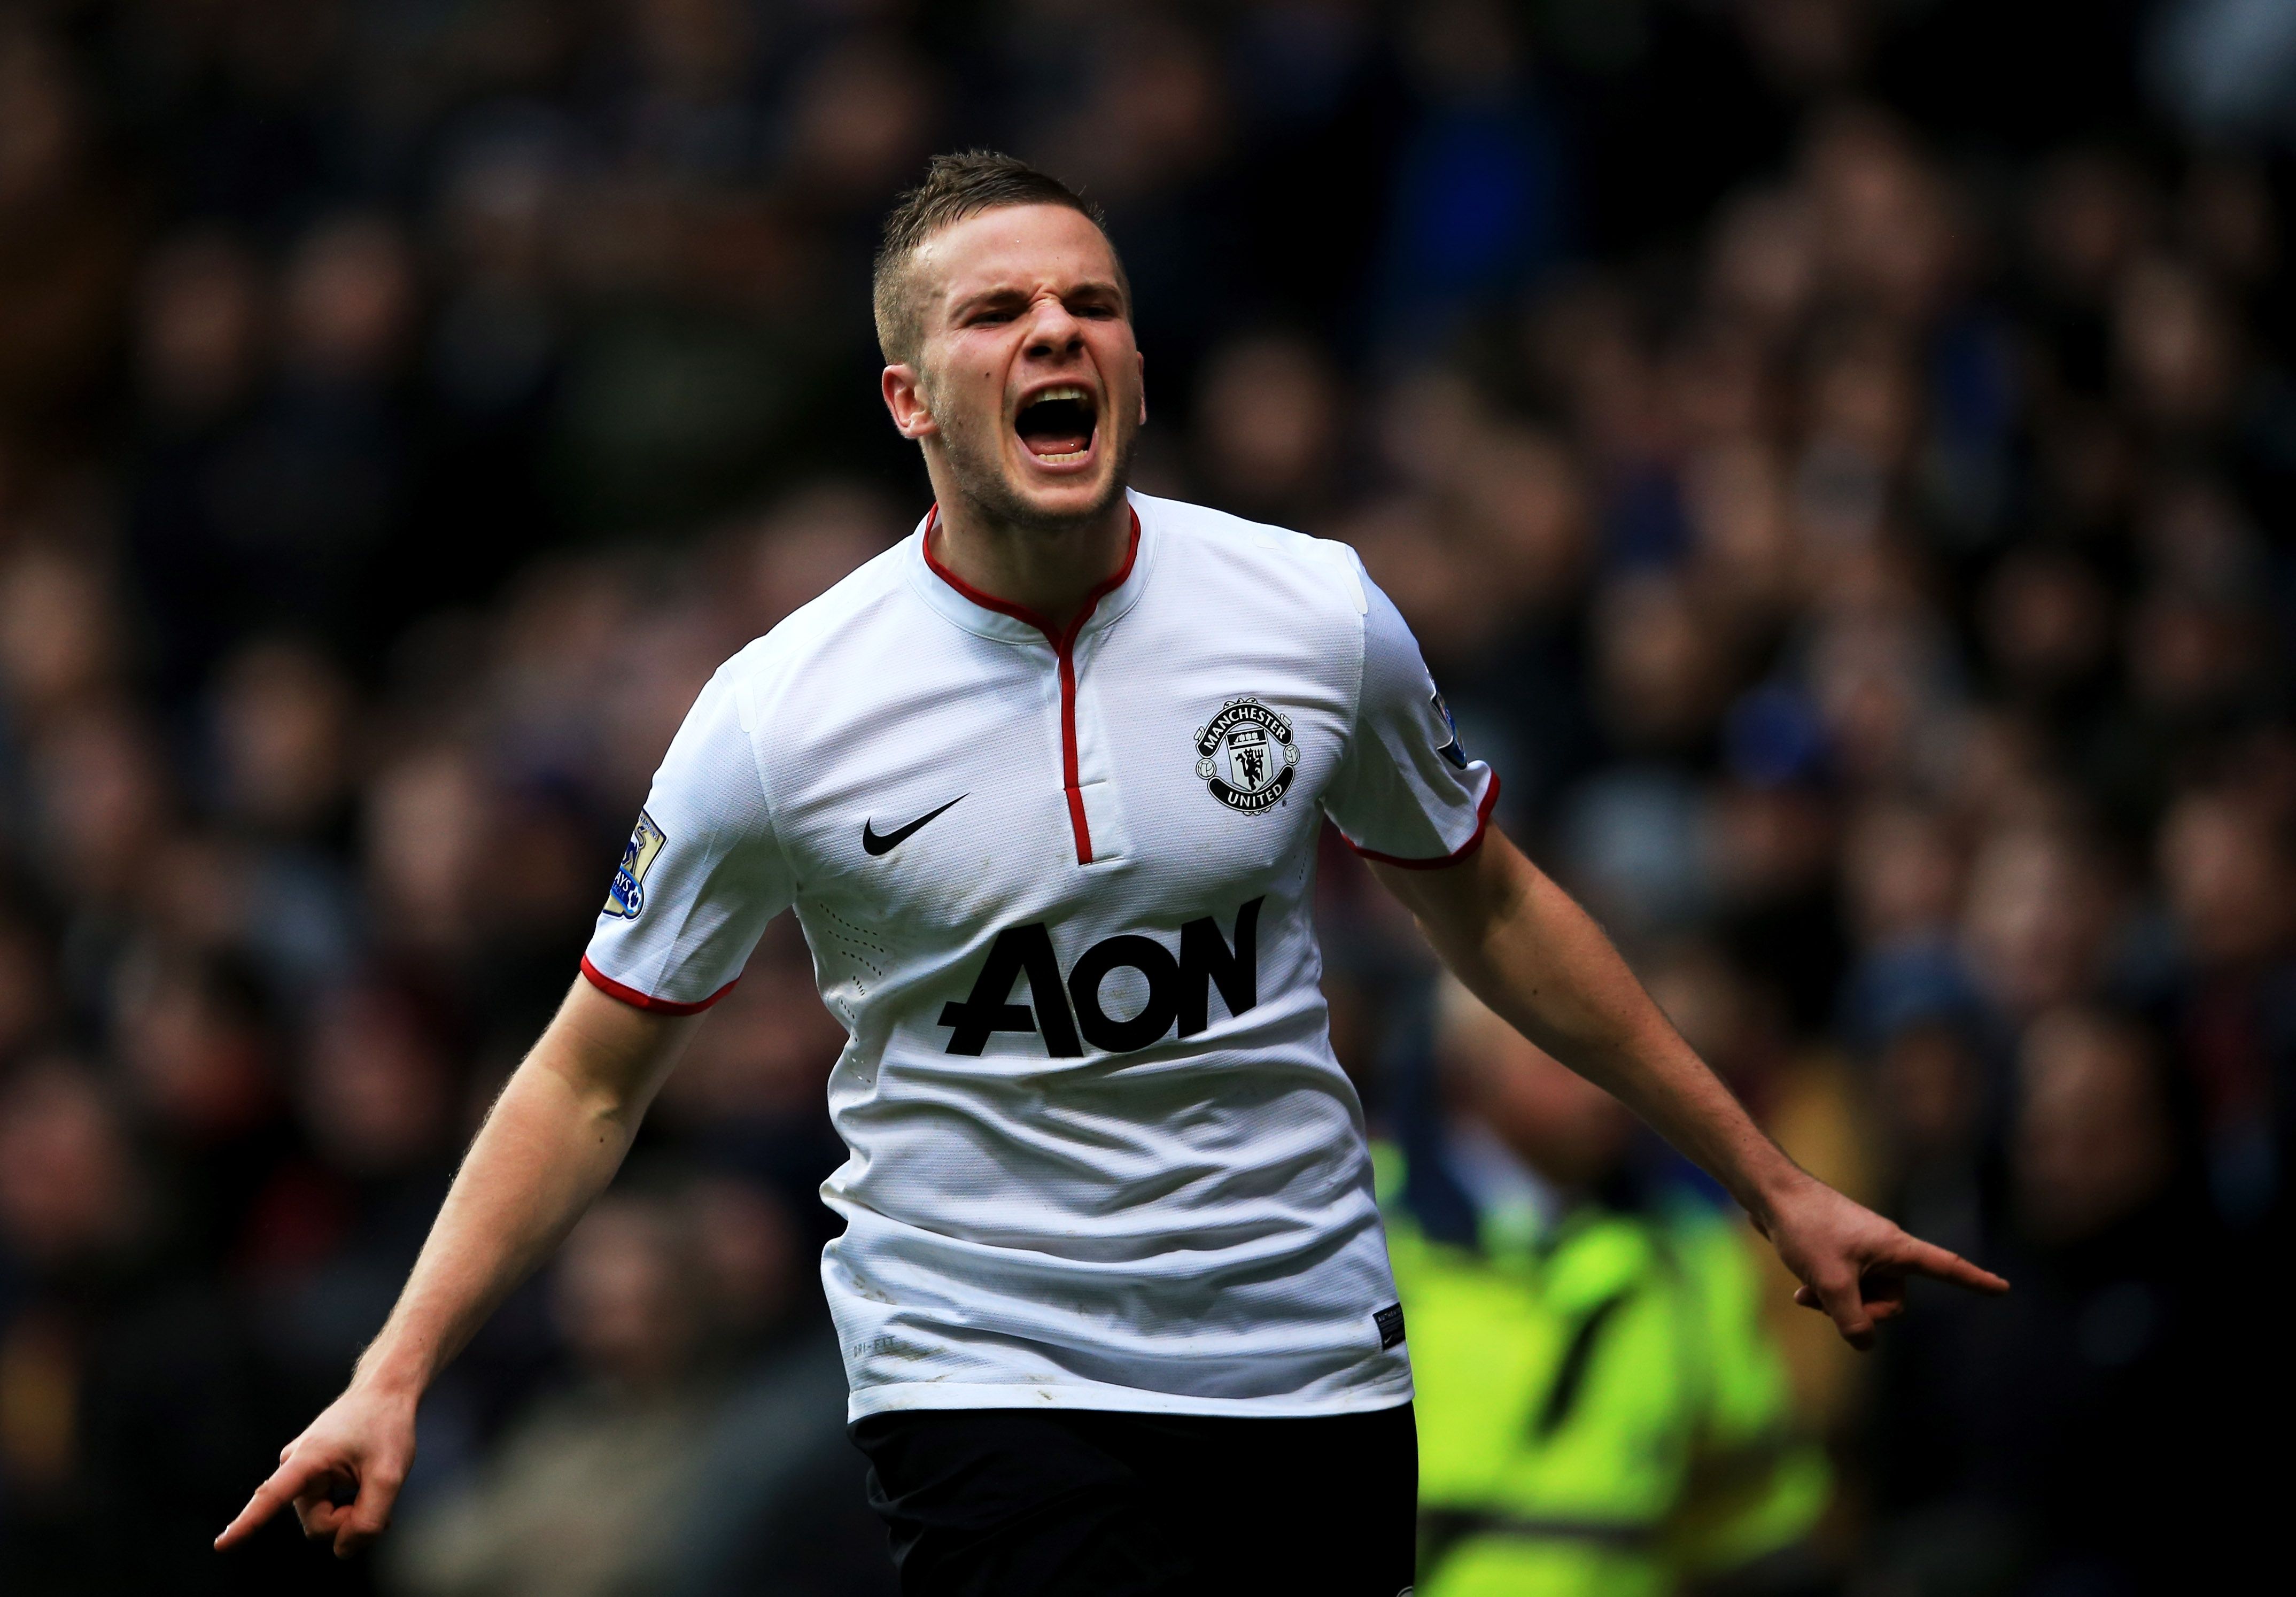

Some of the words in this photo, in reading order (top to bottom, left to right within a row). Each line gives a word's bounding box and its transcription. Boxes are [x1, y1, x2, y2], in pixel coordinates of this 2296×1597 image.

[1204, 707, 1286, 750] MANCHESTER
[1228, 784, 1282, 807] UNITED
[639, 815, 660, 841] HAMPIONS
[615, 871, 631, 891] AYS
